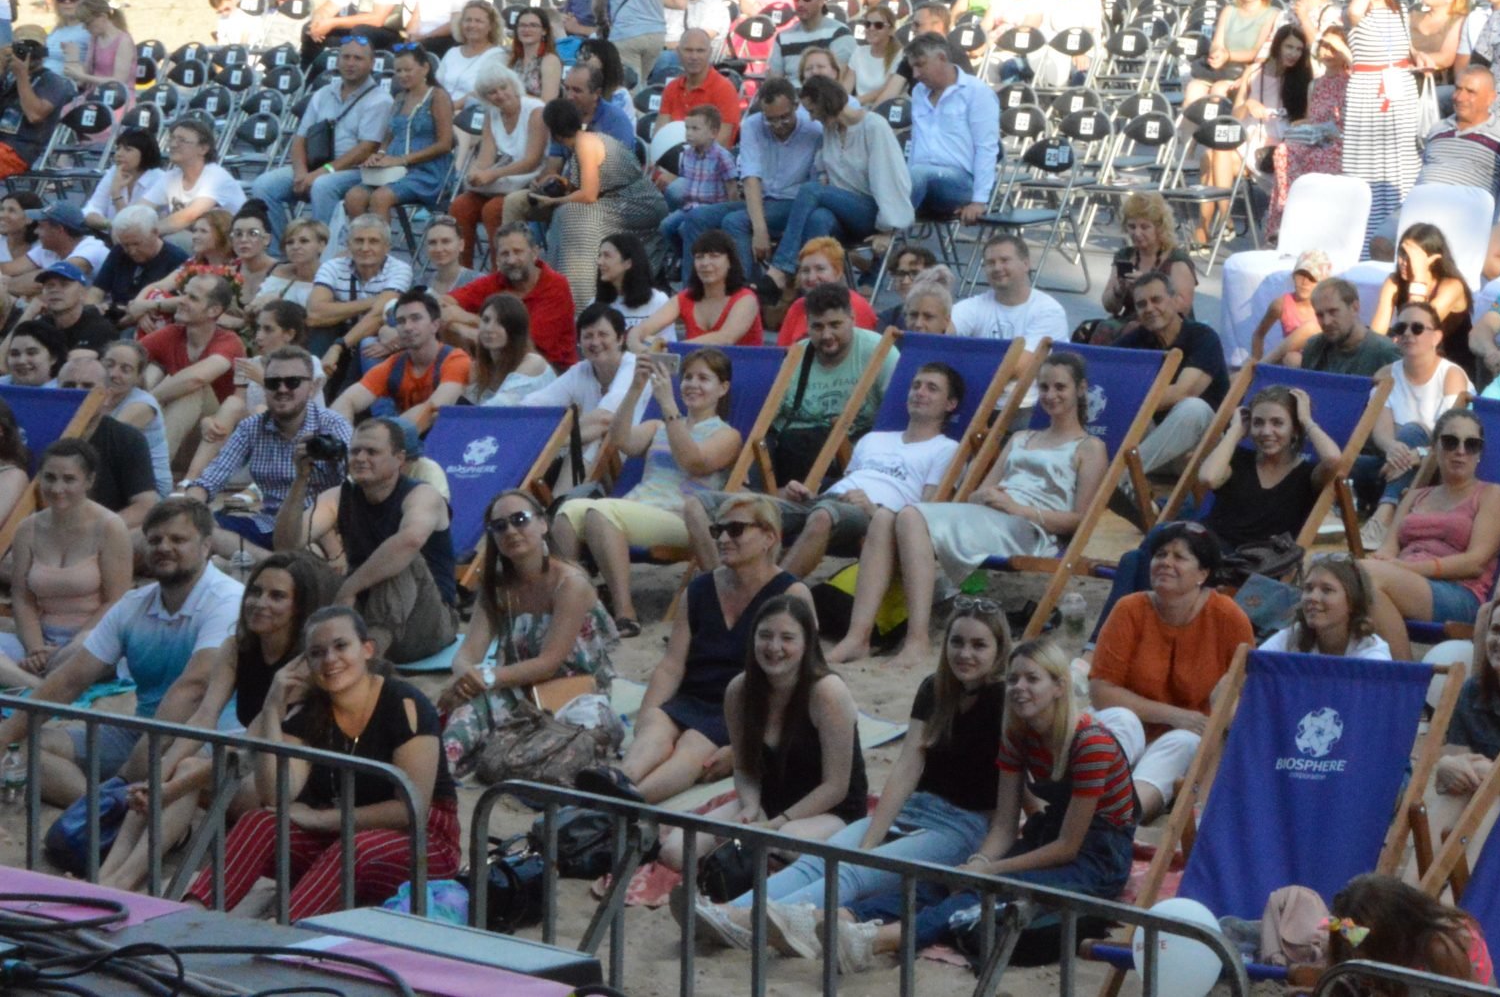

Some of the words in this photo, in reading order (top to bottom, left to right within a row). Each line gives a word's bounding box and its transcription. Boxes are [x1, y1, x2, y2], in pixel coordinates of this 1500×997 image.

[1082, 121, 1093, 131] 23
[1148, 125, 1158, 135] 24
[1217, 129, 1228, 139] 25
[1047, 152, 1058, 162] 25
[1275, 757, 1347, 772] BIOSPHERE
